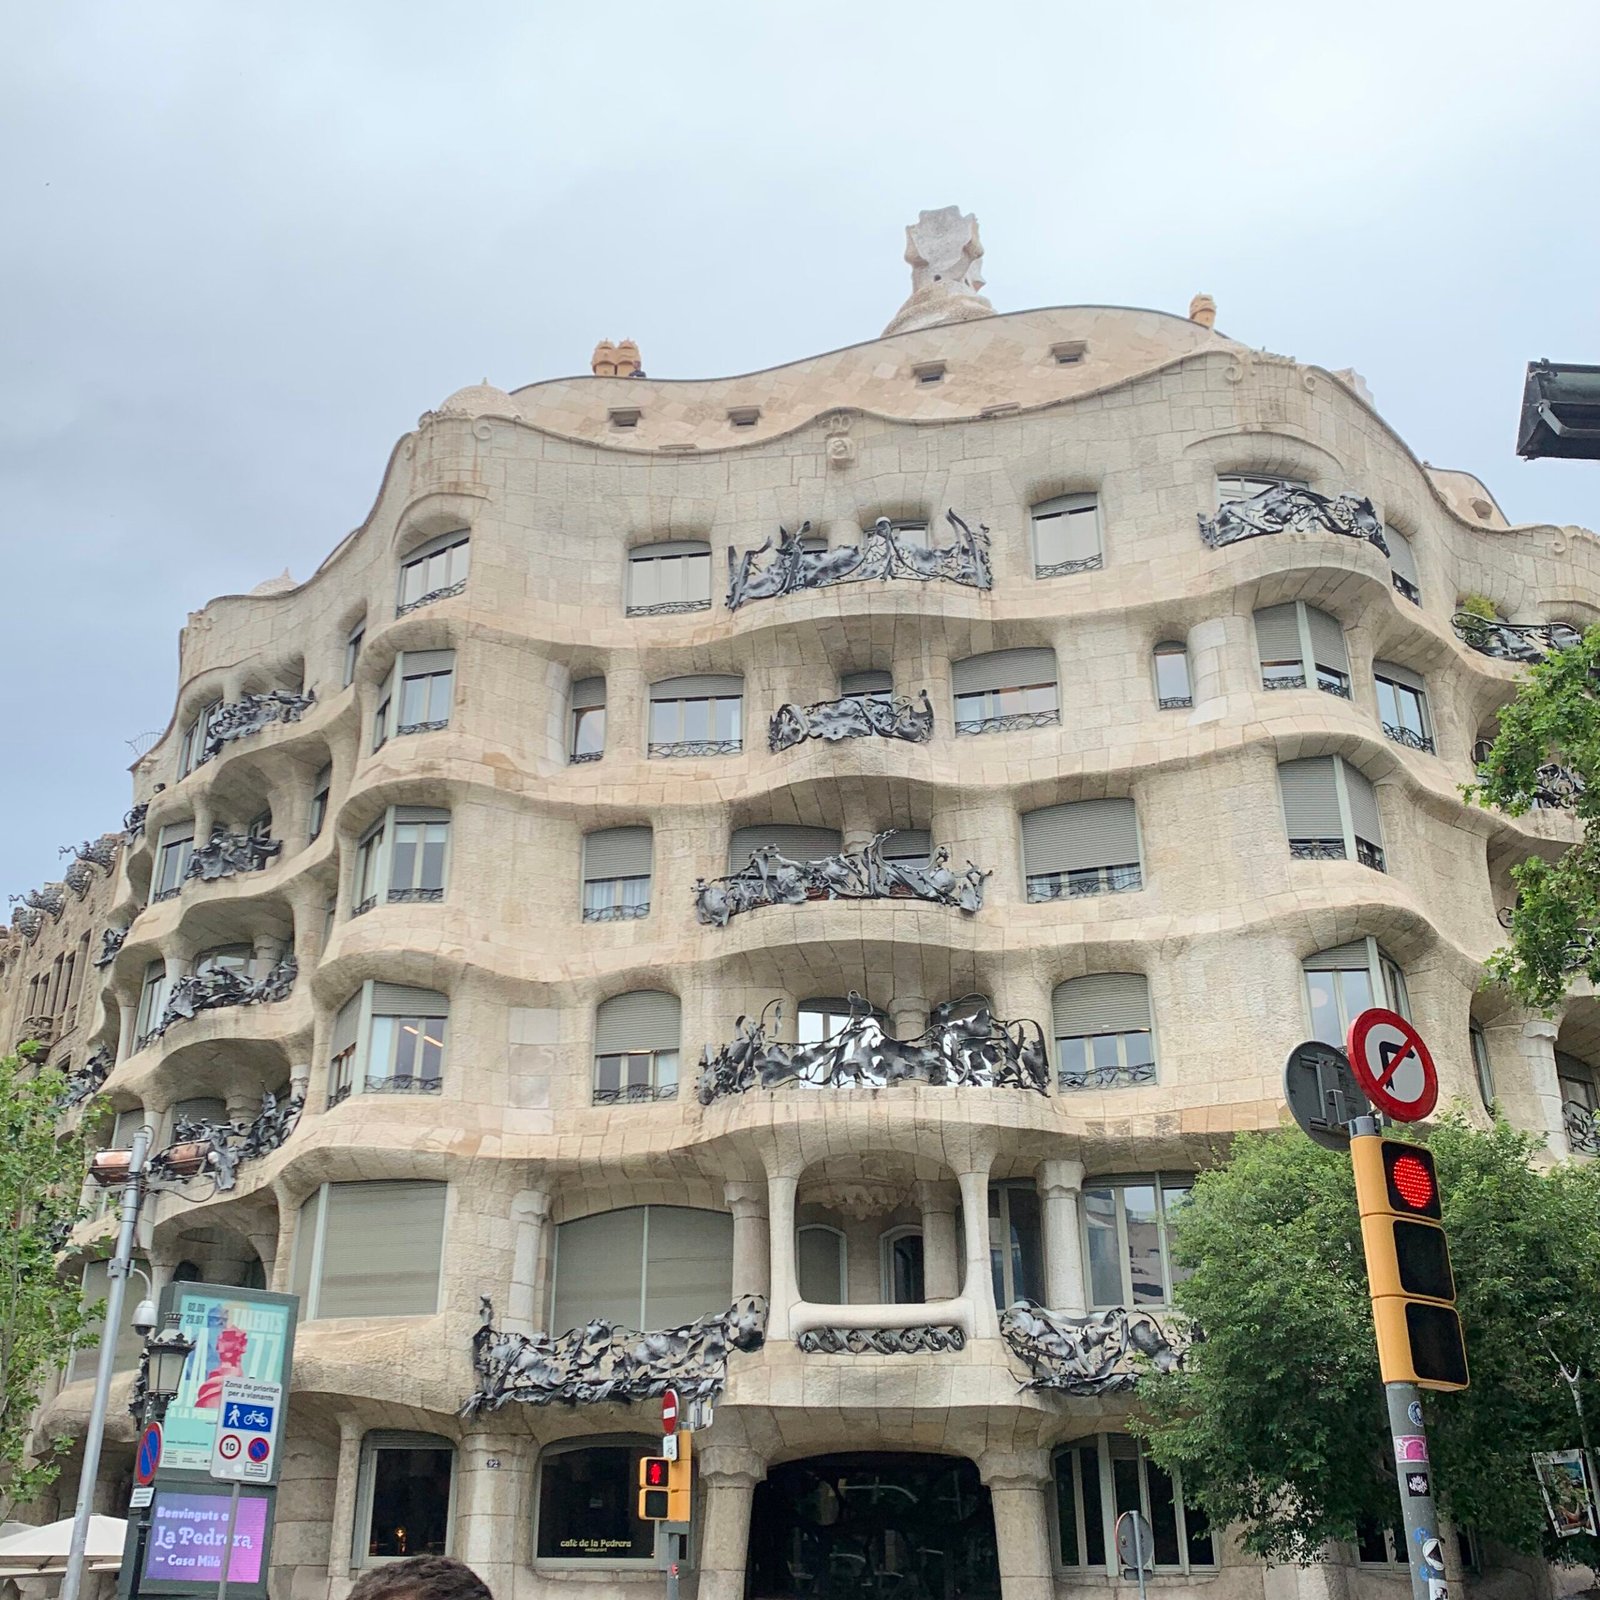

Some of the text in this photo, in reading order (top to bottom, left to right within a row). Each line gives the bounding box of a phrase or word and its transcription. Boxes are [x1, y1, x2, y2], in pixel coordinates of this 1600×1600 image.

[225, 1380, 242, 1389] Zona
[253, 1385, 280, 1394] prioritat
[246, 1392, 274, 1401] vianants
[225, 1443, 236, 1451] 10
[157, 1506, 229, 1522] Benvinguts a
[155, 1525, 177, 1549] La
[579, 1539, 590, 1547] de
[591, 1539, 599, 1547] la
[600, 1539, 632, 1547] Pedrera
[167, 1554, 196, 1567] Casa
